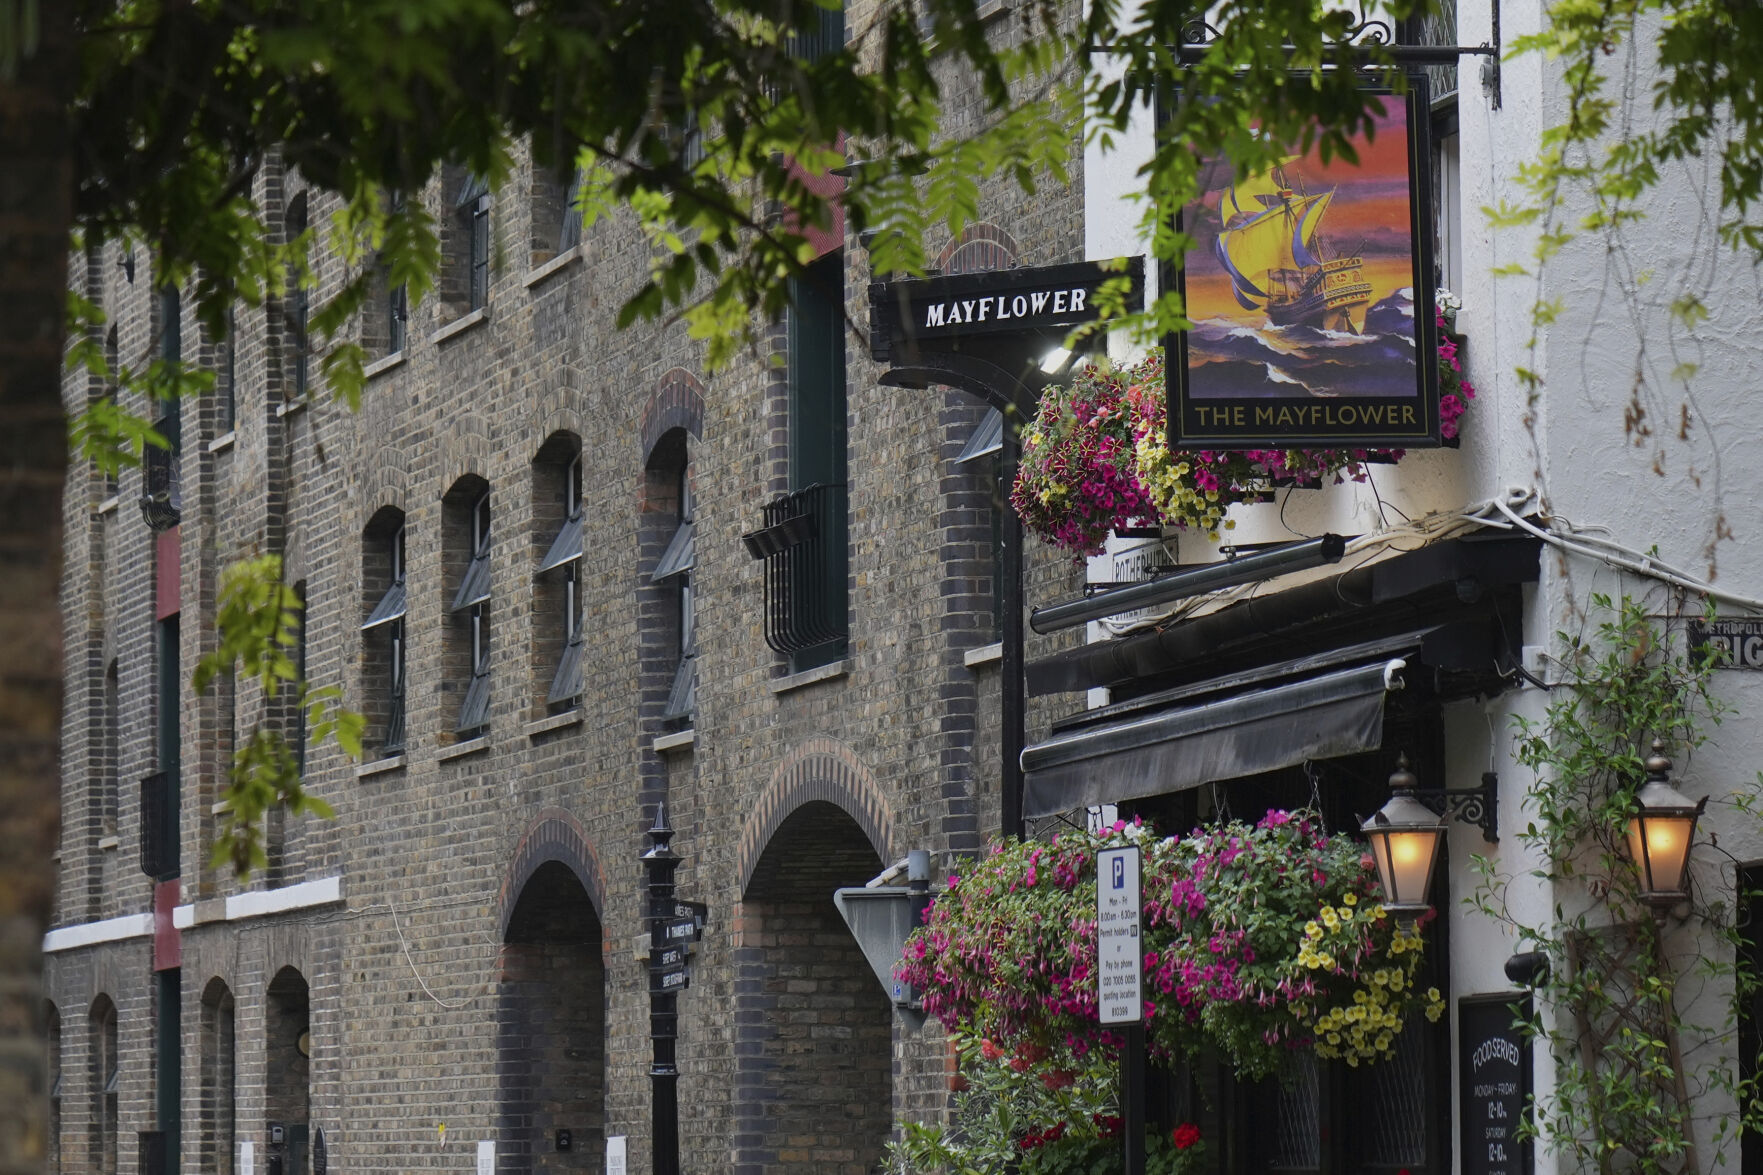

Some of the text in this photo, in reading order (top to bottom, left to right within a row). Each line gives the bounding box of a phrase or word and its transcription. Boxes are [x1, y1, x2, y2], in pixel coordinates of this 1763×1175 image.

[926, 288, 1086, 327] MAYFLOWER
[1195, 405, 1416, 426] THE MAYFLOWER
[1710, 636, 1763, 667] RIG
[1114, 860, 1122, 887] P
[1109, 897, 1118, 906] Mon
[1100, 928, 1113, 938] Permit
[1113, 927, 1129, 937] holders
[1105, 959, 1133, 972] Pay by phone
[1103, 976, 1112, 987] 020
[1103, 989, 1136, 1003] quoting location
[1473, 1037, 1519, 1074] FOOD SERVED
